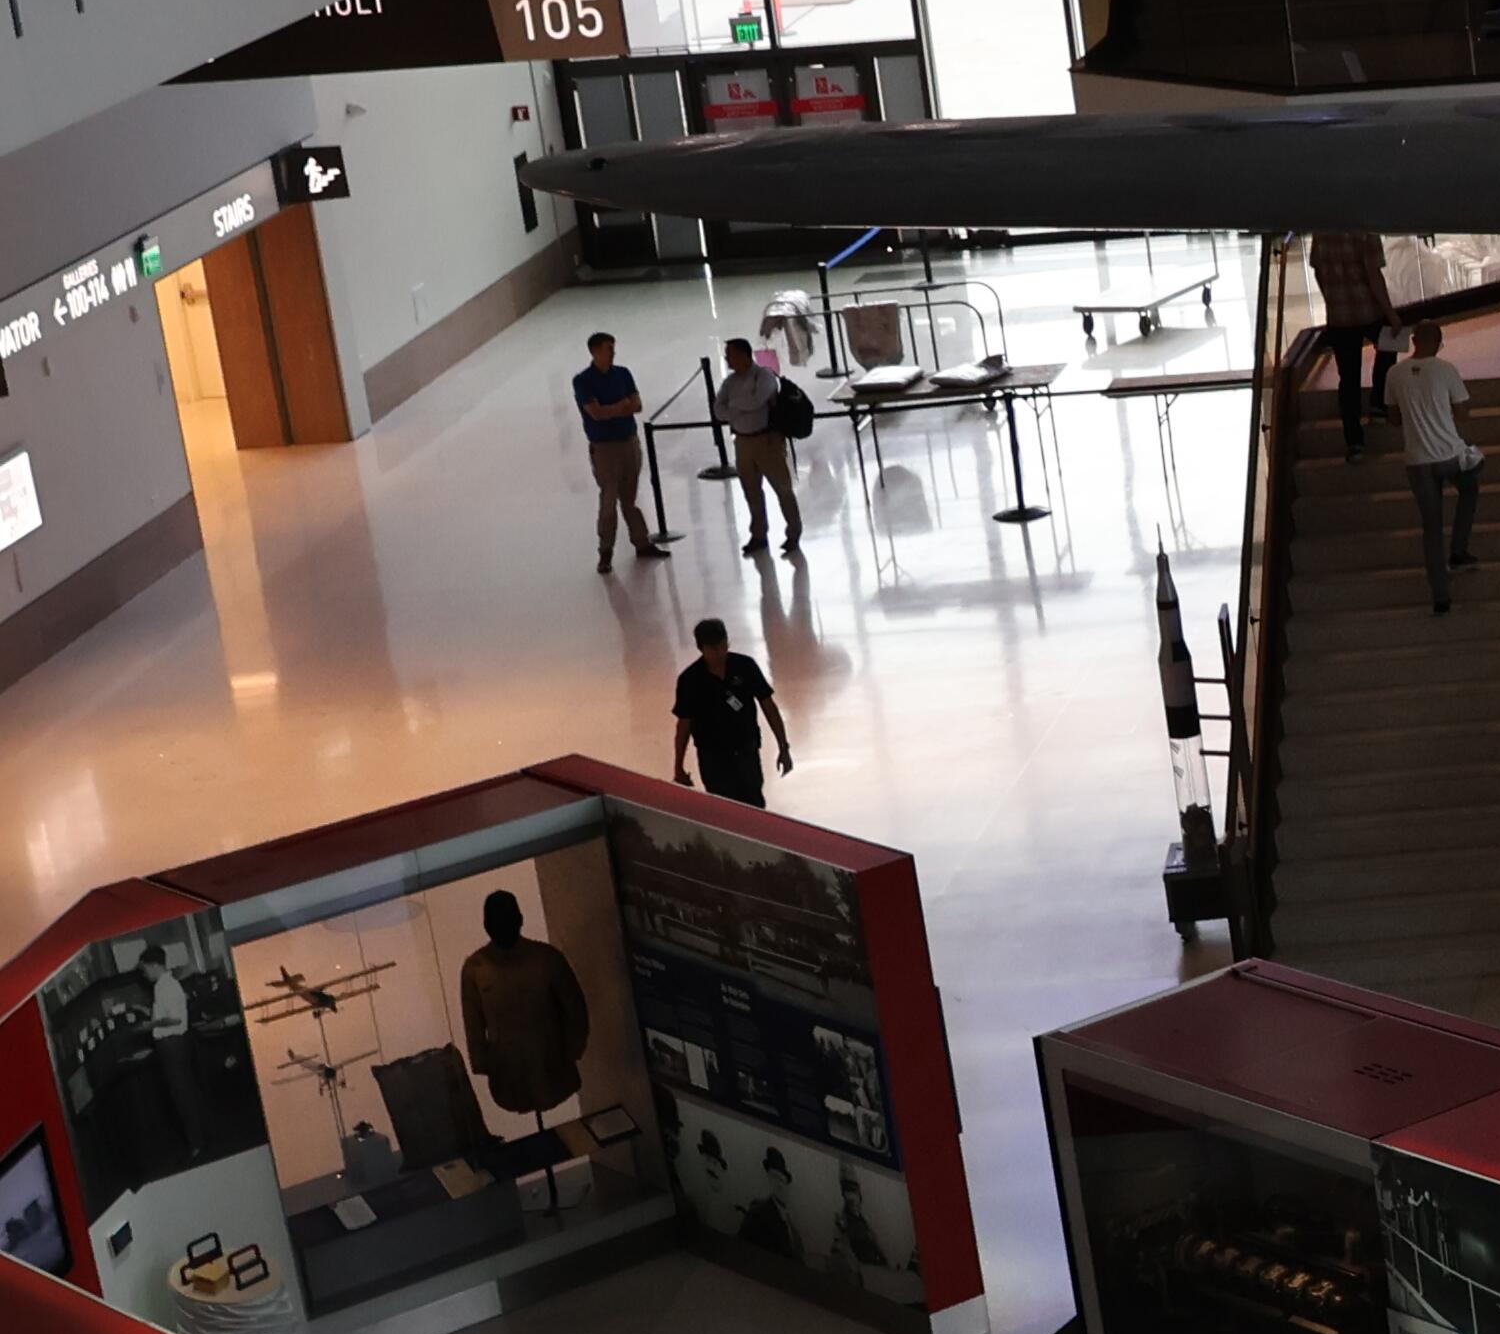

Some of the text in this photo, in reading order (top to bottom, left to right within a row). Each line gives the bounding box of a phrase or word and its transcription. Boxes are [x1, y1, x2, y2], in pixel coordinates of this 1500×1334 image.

[213, 194, 255, 238] STAIRS
[62, 259, 99, 290] GALLERIES
[66, 273, 110, 319] 100-114
